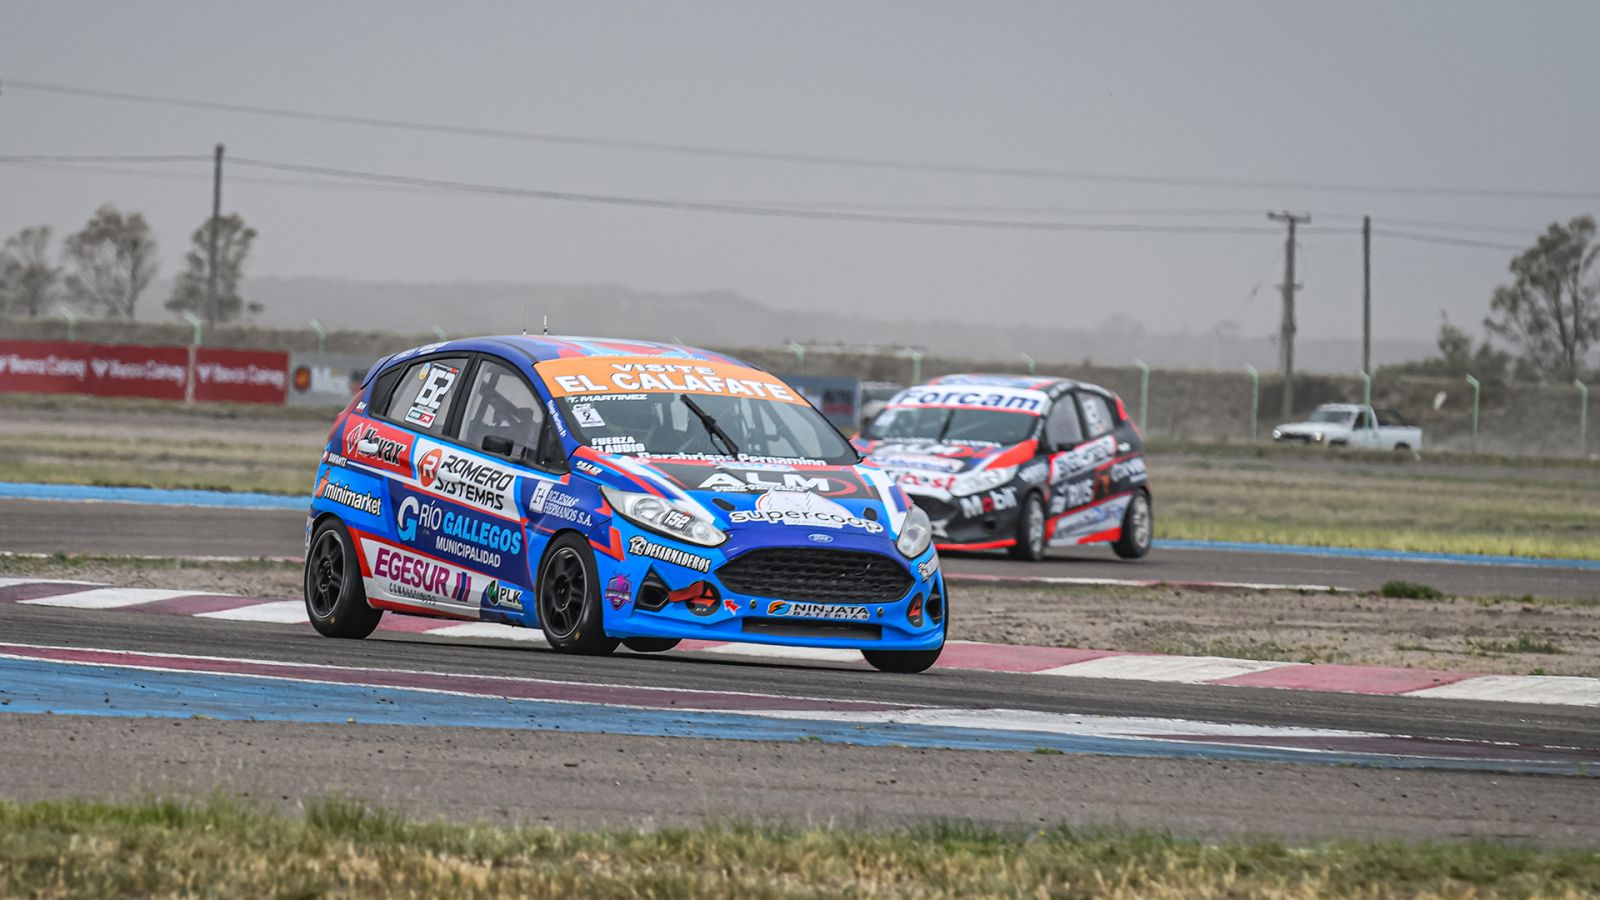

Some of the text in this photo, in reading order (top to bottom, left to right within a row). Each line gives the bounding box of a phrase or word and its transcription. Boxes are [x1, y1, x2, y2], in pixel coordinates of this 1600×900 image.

[611, 363, 716, 376] VISITE
[554, 373, 794, 400] EL CALAFATE
[580, 394, 648, 402] MARTINEZ
[898, 388, 1042, 411] Forcam
[591, 436, 636, 445] FUERZA
[441, 455, 515, 490] ROMERO
[698, 472, 830, 491] ALM
[324, 482, 382, 516] minimarket
[435, 478, 505, 511] SISTEMAS
[544, 502, 592, 527] HERMANOS S.A.
[664, 510, 690, 529] 152
[419, 500, 521, 555] RÍO GALLEGOS
[435, 535, 501, 568] MUNICIPALIDAD
[644, 543, 712, 573] DESARMADEROS
[375, 548, 450, 597] EGESUR
[499, 588, 521, 605] PLK
[793, 611, 870, 620] BATERIAS
[794, 603, 869, 615] NINJATA
